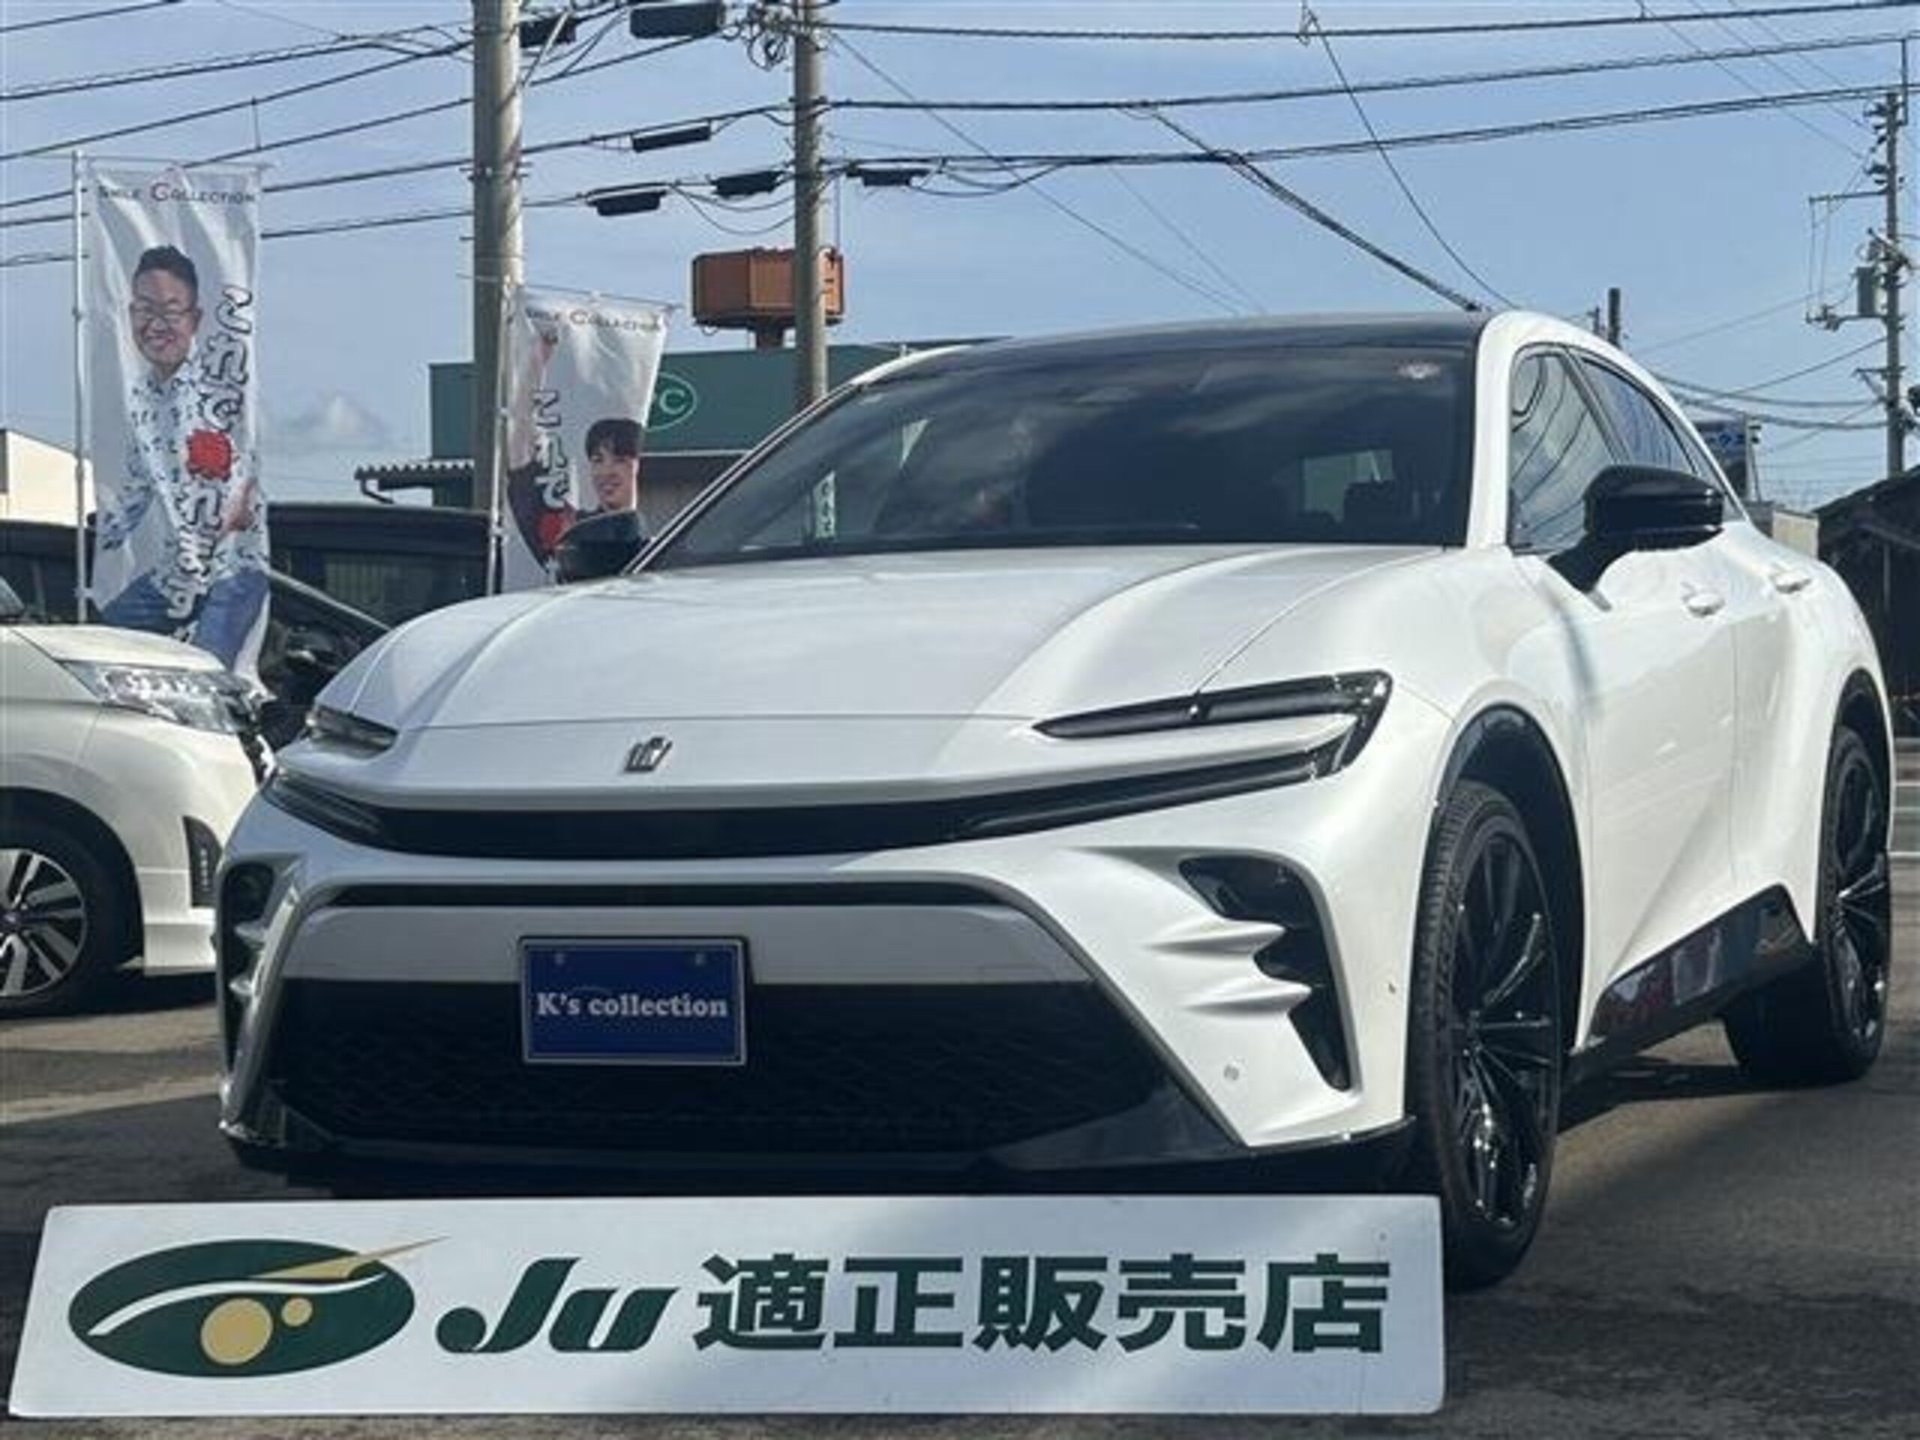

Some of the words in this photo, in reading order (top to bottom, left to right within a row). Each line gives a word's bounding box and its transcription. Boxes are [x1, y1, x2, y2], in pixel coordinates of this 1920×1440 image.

[537, 992, 580, 1016] K's
[588, 992, 728, 1017] collection
[693, 1253, 1391, 1353] 適正販売店
